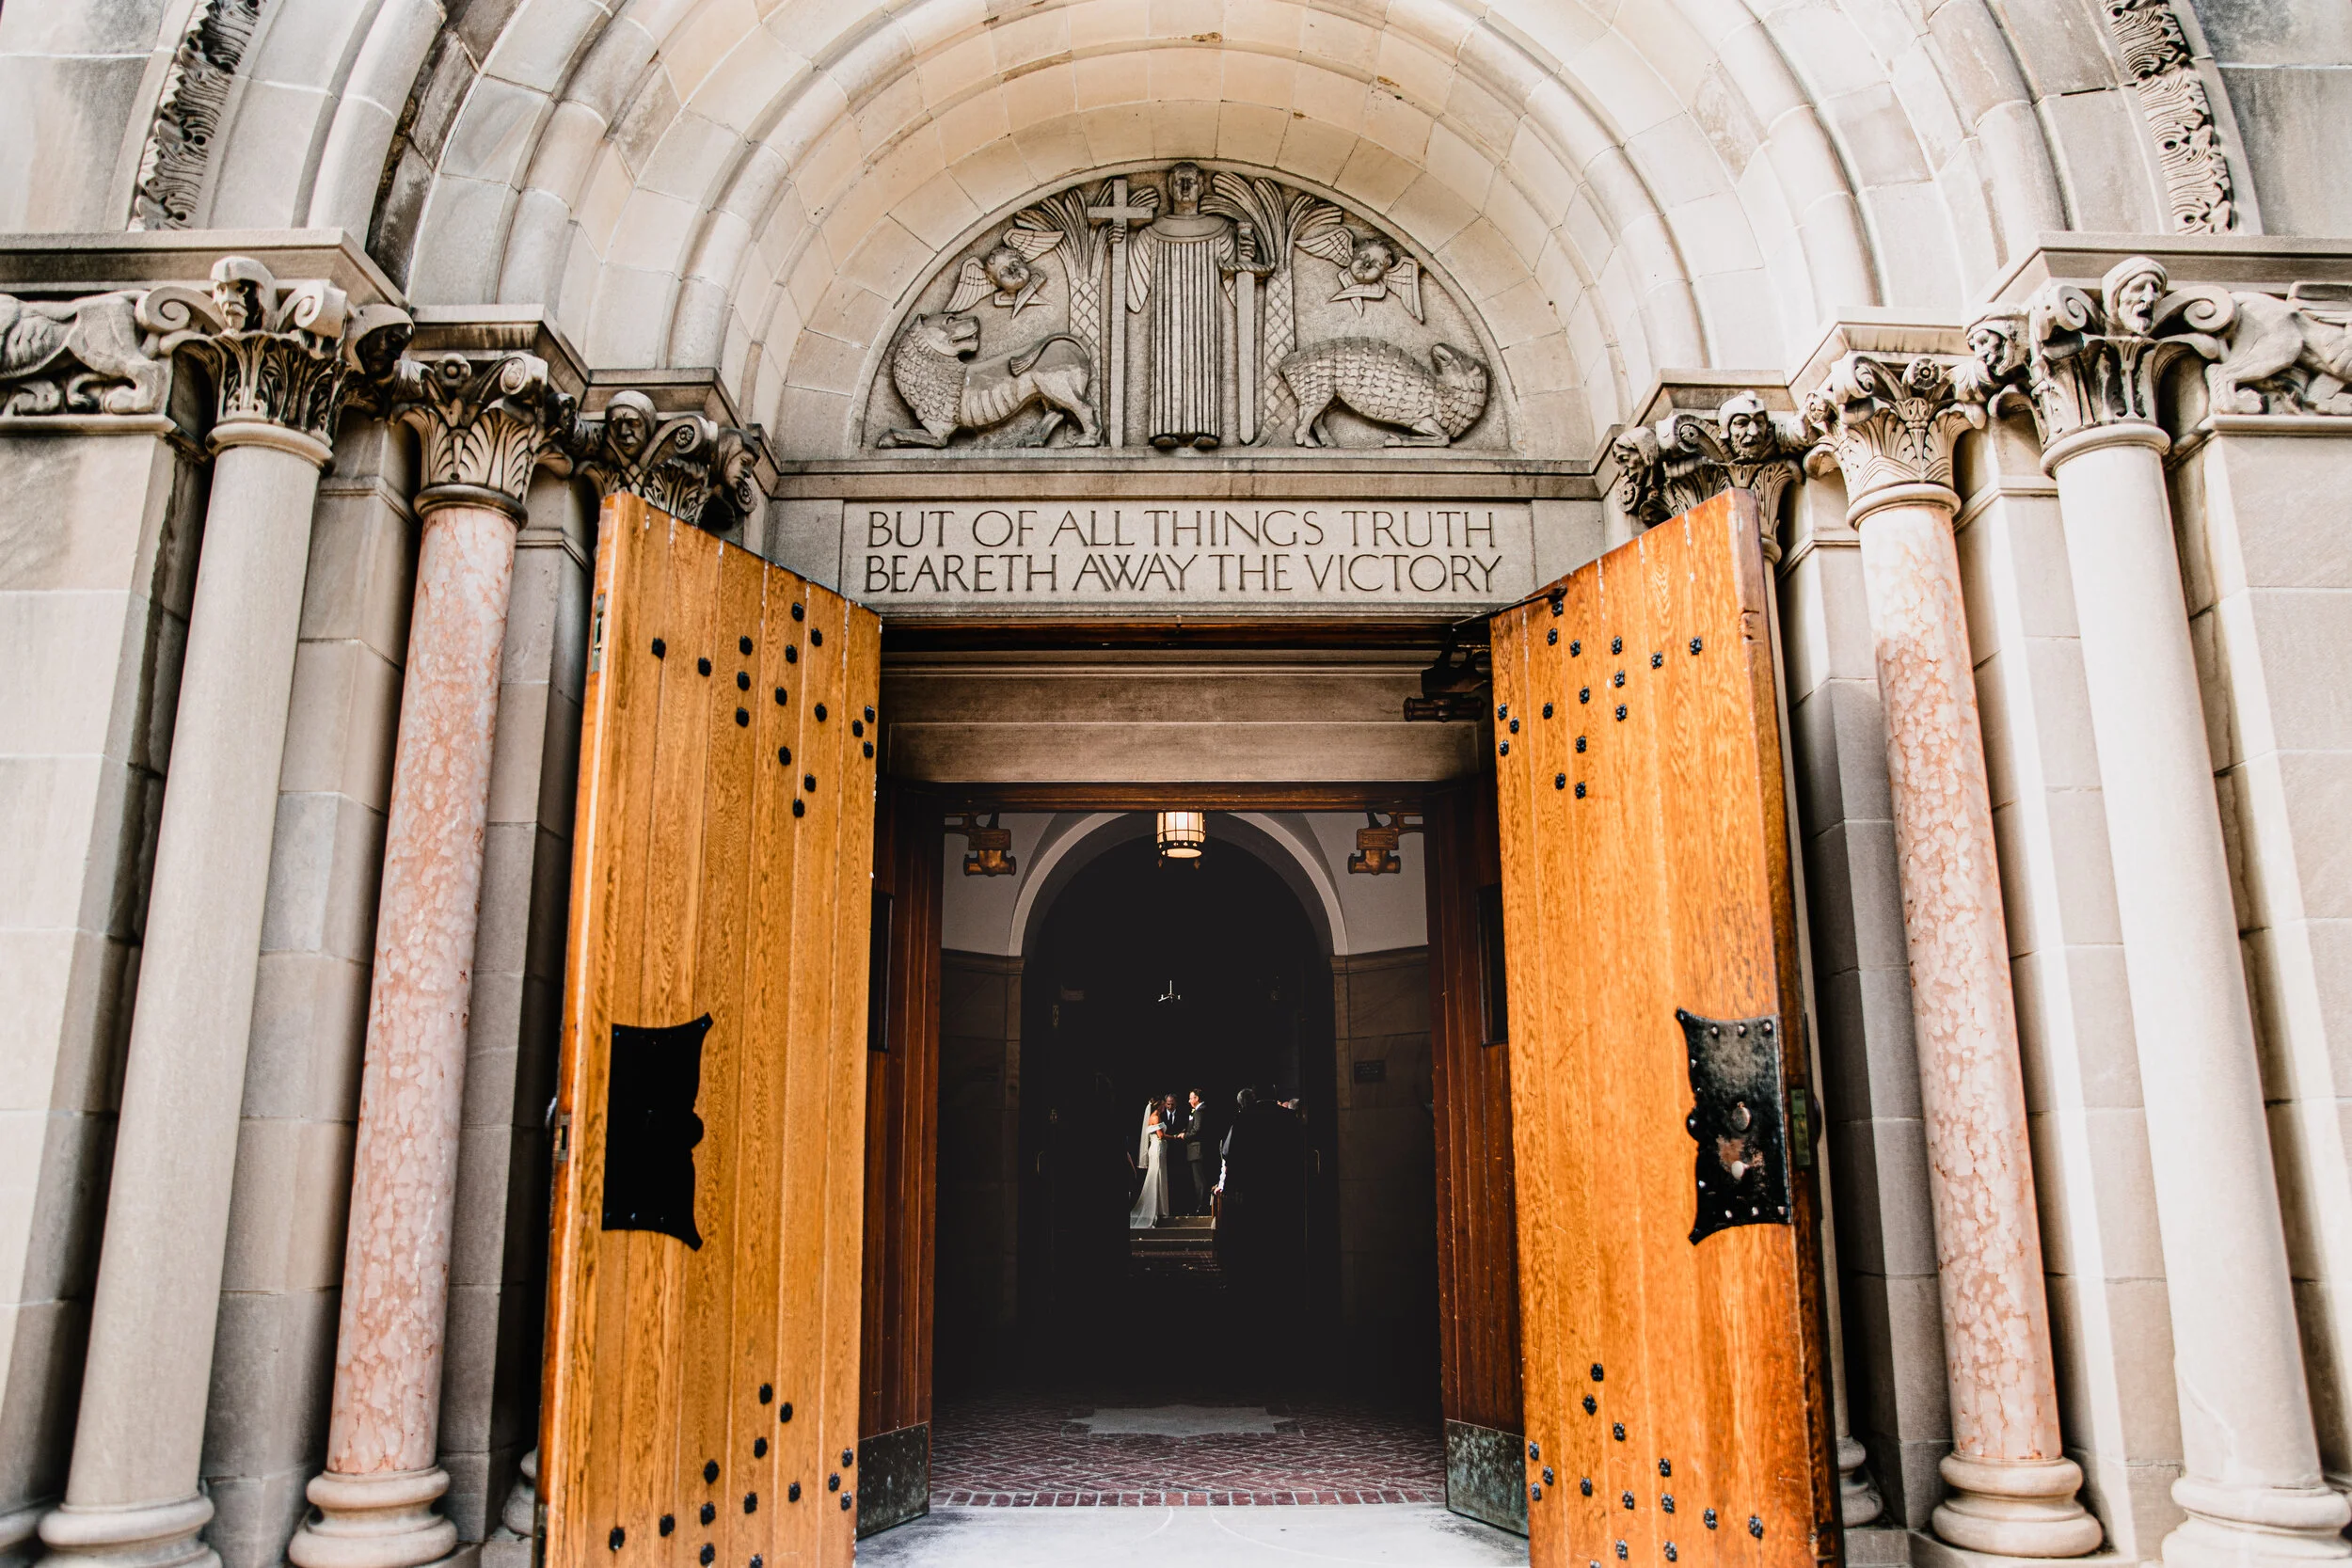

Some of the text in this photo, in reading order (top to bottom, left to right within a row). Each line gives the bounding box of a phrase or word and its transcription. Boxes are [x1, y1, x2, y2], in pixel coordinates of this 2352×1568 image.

[866, 509, 1496, 548] BUT OF ALL THINGS TRUTH
[864, 553, 1502, 593] BEARETH AWAY THE VICTORY
